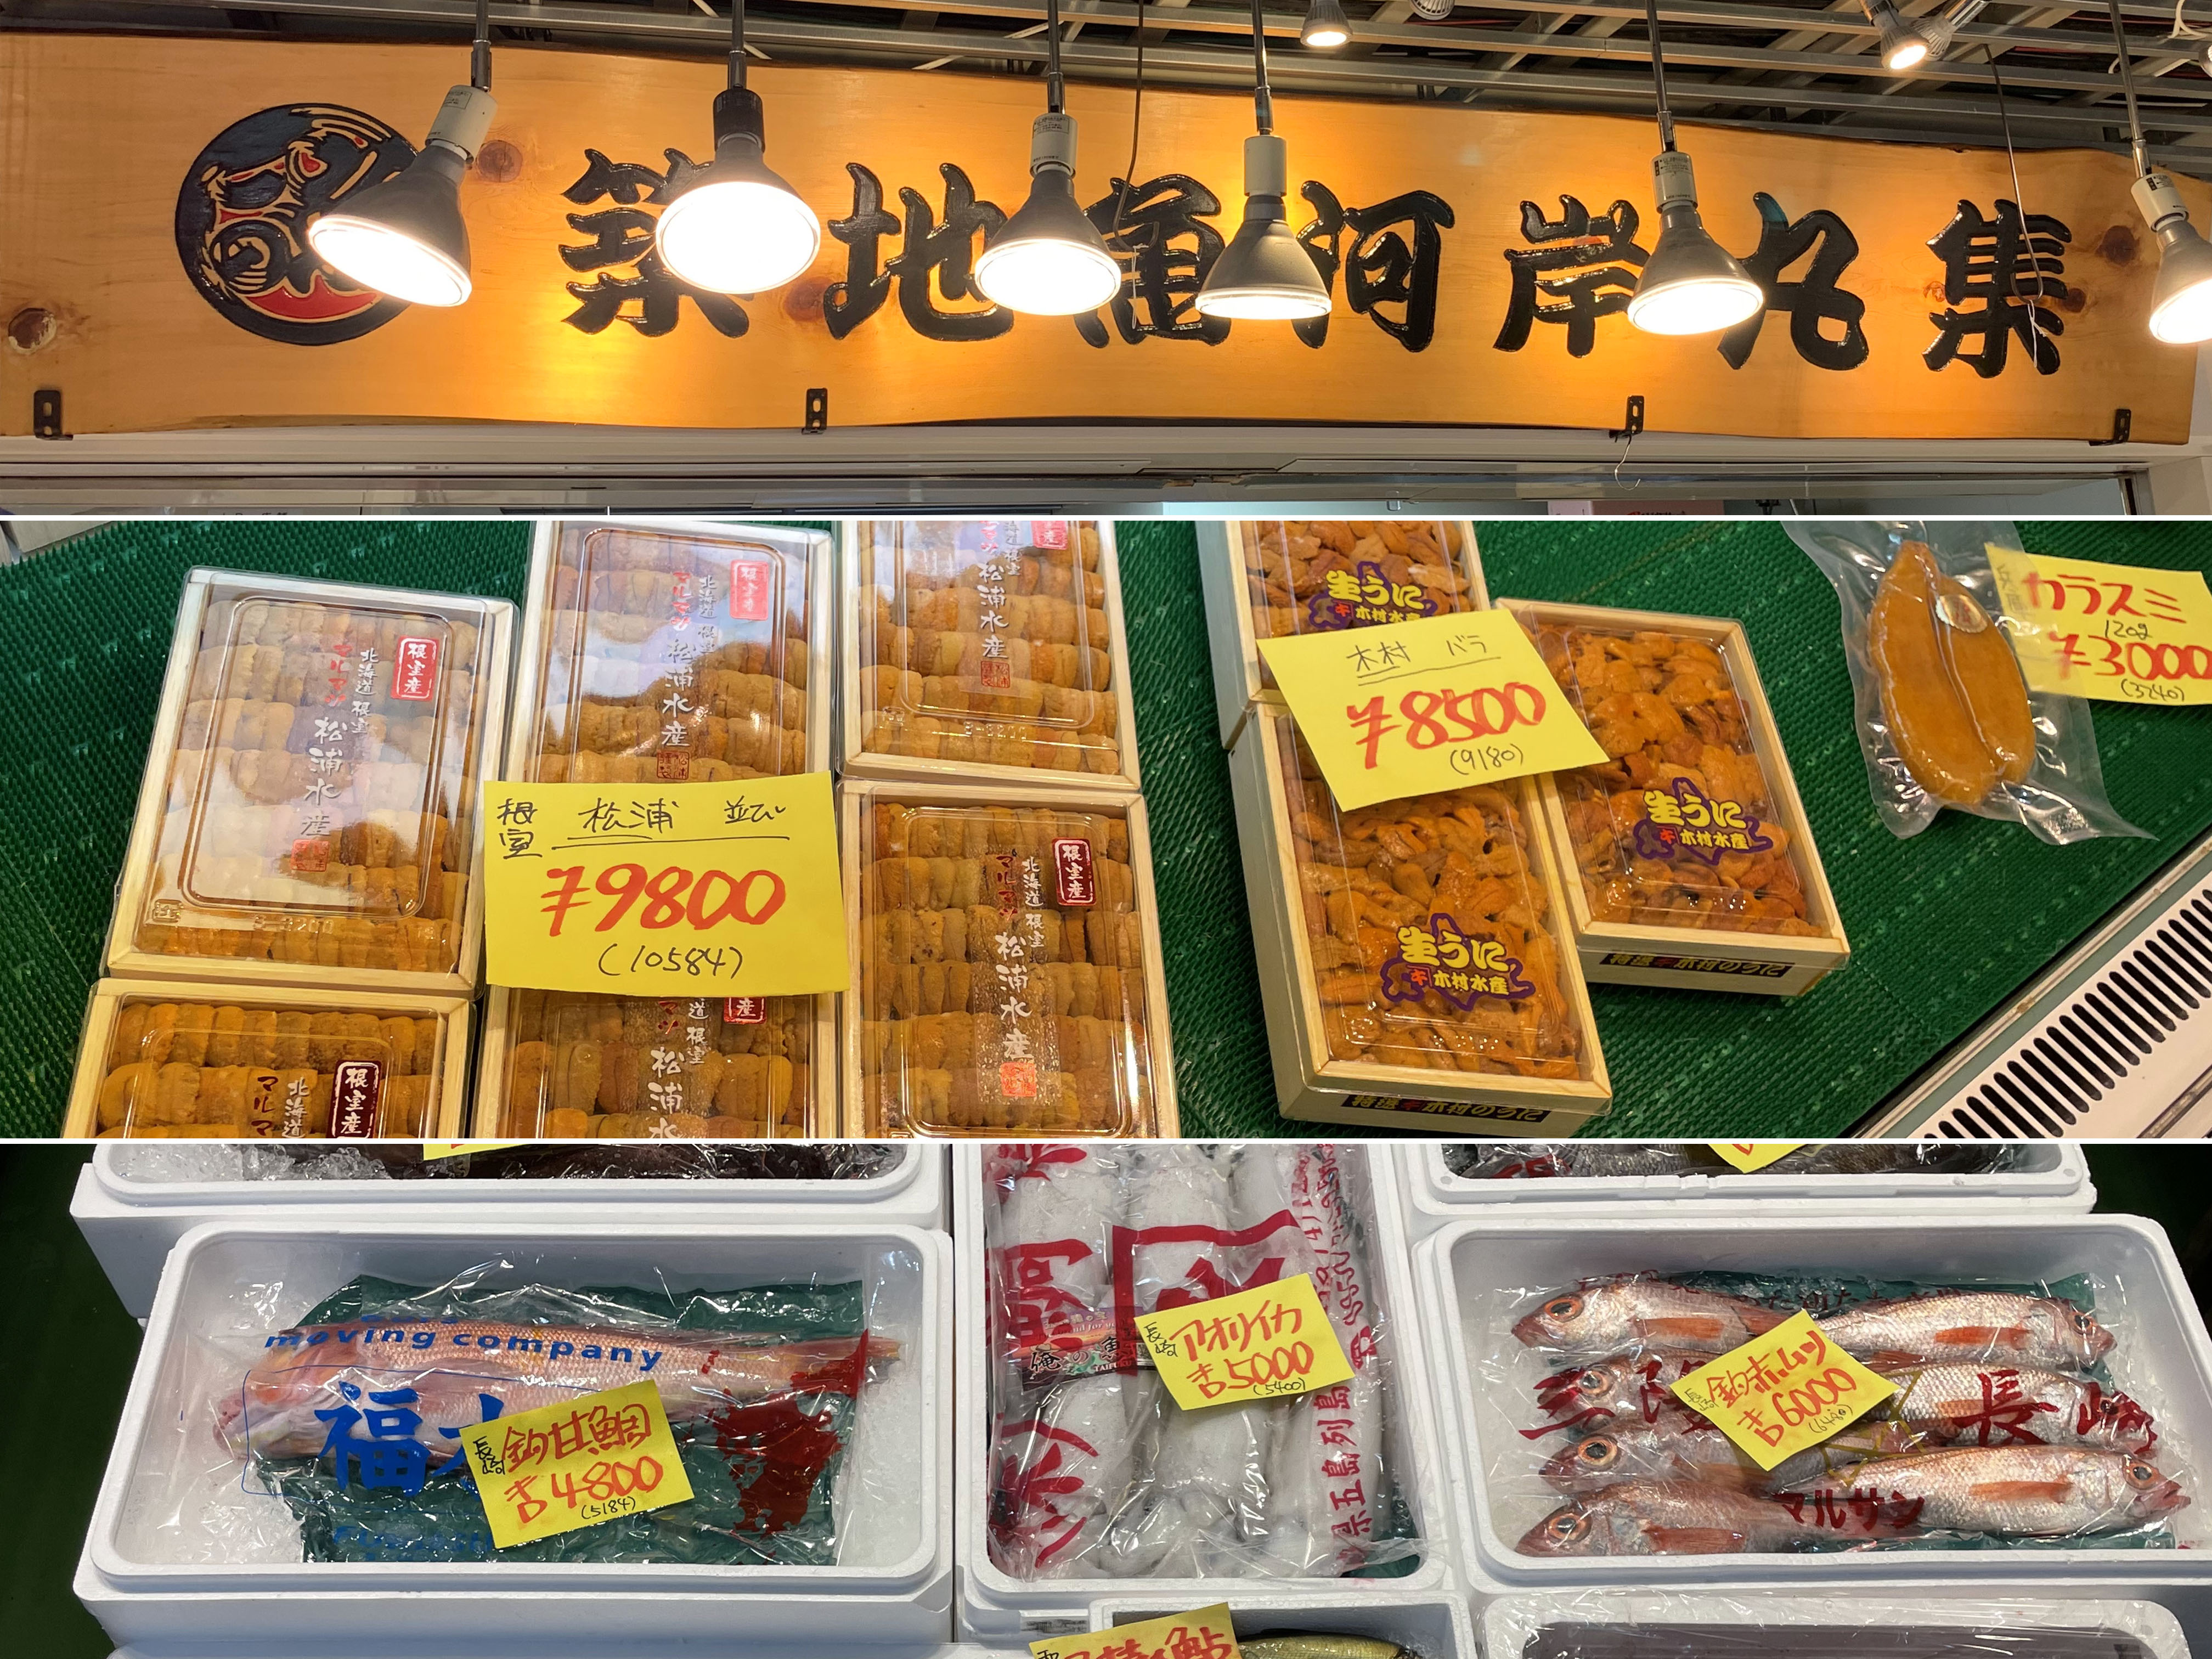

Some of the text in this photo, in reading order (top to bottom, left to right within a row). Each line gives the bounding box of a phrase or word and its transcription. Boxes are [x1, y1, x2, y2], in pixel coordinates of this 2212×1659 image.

[976, 562, 1009, 659] 松浦水産
[1325, 569, 1425, 610] 生うに
[2022, 571, 2187, 624] カラスミ
[404, 643, 427, 694] 根室産
[1346, 635, 1487, 673] 木村 バラ
[351, 647, 379, 734] 北海道 根室
[660, 639, 697, 748] 松浦水産
[1346, 681, 1547, 770] ¥8500
[301, 716, 348, 837] 松浦水産
[1449, 743, 1525, 775] (9180)
[495, 797, 543, 860] 根室
[578, 797, 680, 833] 松浦
[1643, 789, 1747, 829] 生うに
[1679, 828, 1750, 850] 木村水産
[1060, 844, 1087, 900] 根室産
[540, 862, 787, 937] ¥9800
[1021, 855, 1046, 949] 北海道 根室
[598, 943, 744, 979] (10584)
[1396, 925, 1511, 972] 生うに
[994, 931, 1035, 1059] 松浦水産
[1433, 972, 1510, 996] 木村水産
[686, 1026, 708, 1064] 根室
[281, 1076, 310, 1138] 北海道
[341, 1068, 369, 1135] 根室産
[264, 1326, 663, 1372] moving company
[1169, 1300, 1304, 1361] アオリイカ
[1770, 1486, 1926, 1531] マルサン
